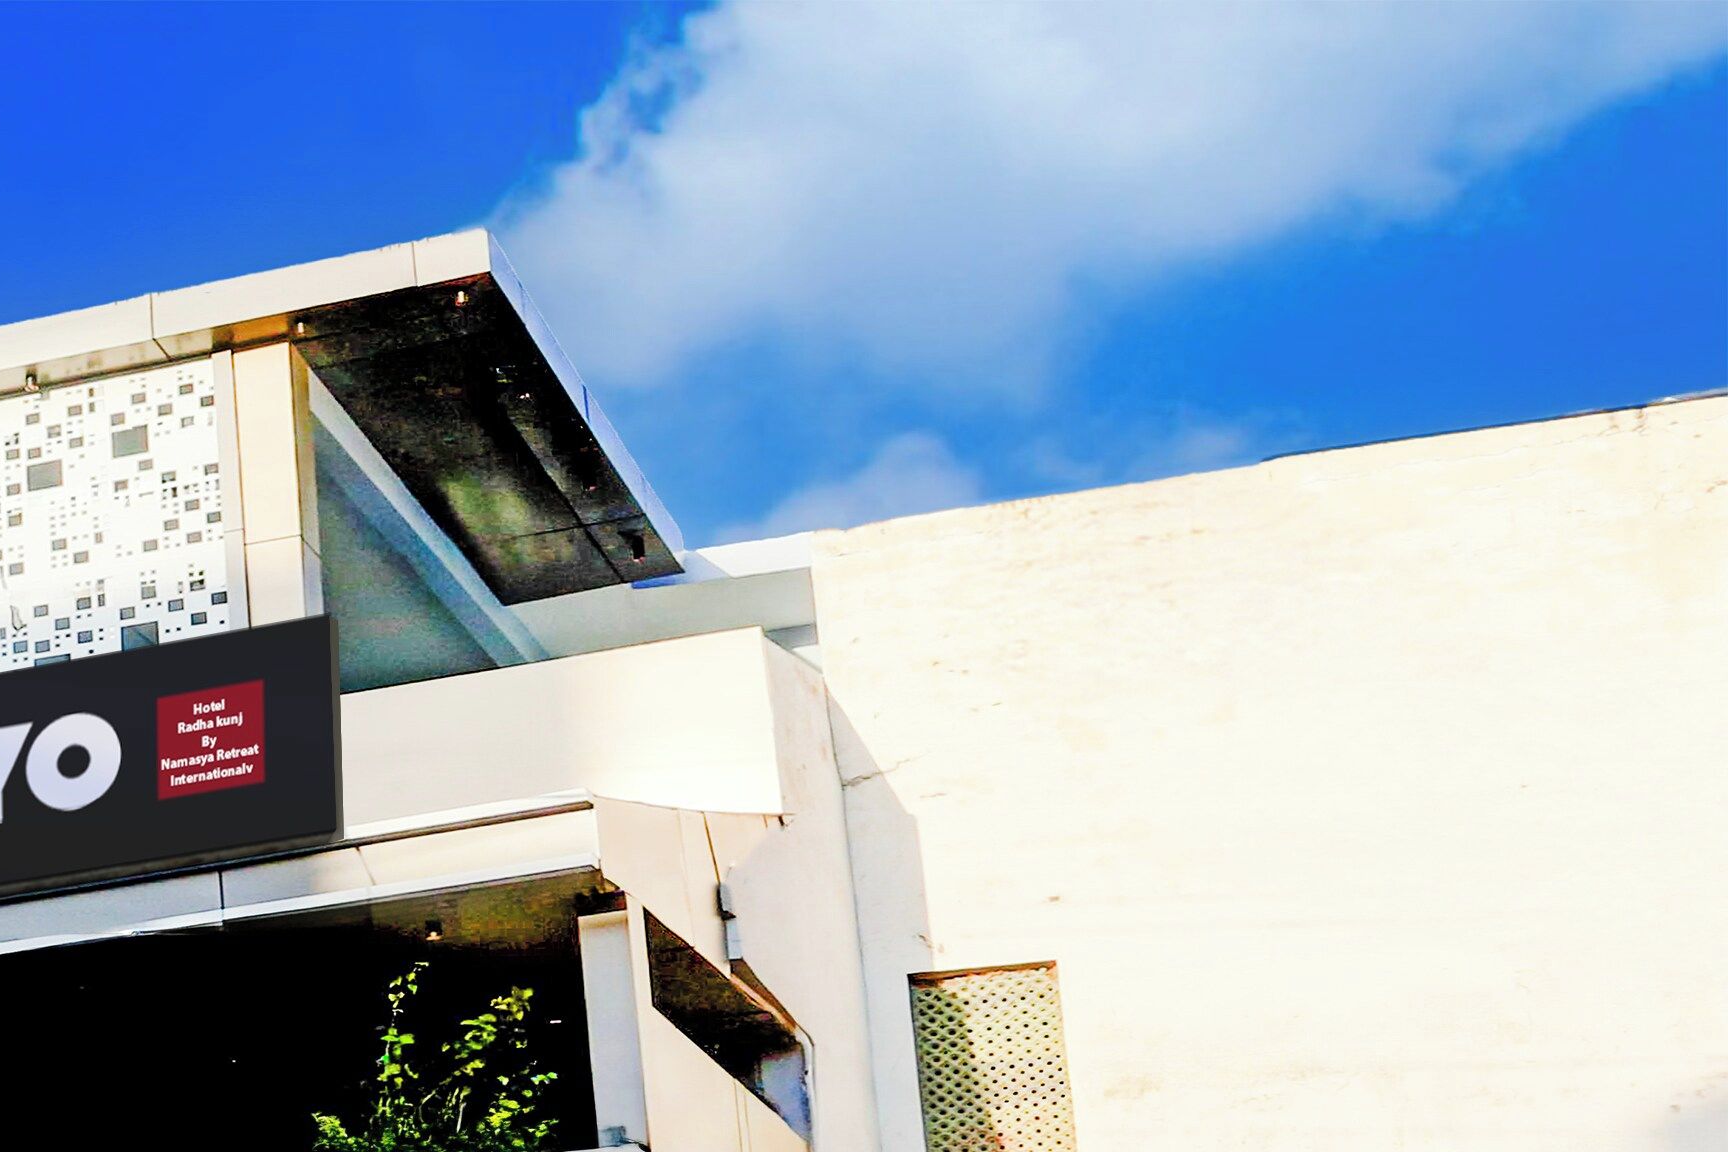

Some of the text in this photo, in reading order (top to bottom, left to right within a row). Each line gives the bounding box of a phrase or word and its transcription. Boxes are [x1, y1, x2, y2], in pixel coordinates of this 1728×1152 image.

[193, 699, 226, 715] Hotel
[177, 711, 244, 734] Radha kunj
[201, 735, 218, 749] By
[160, 743, 260, 771] Namasya Retreat
